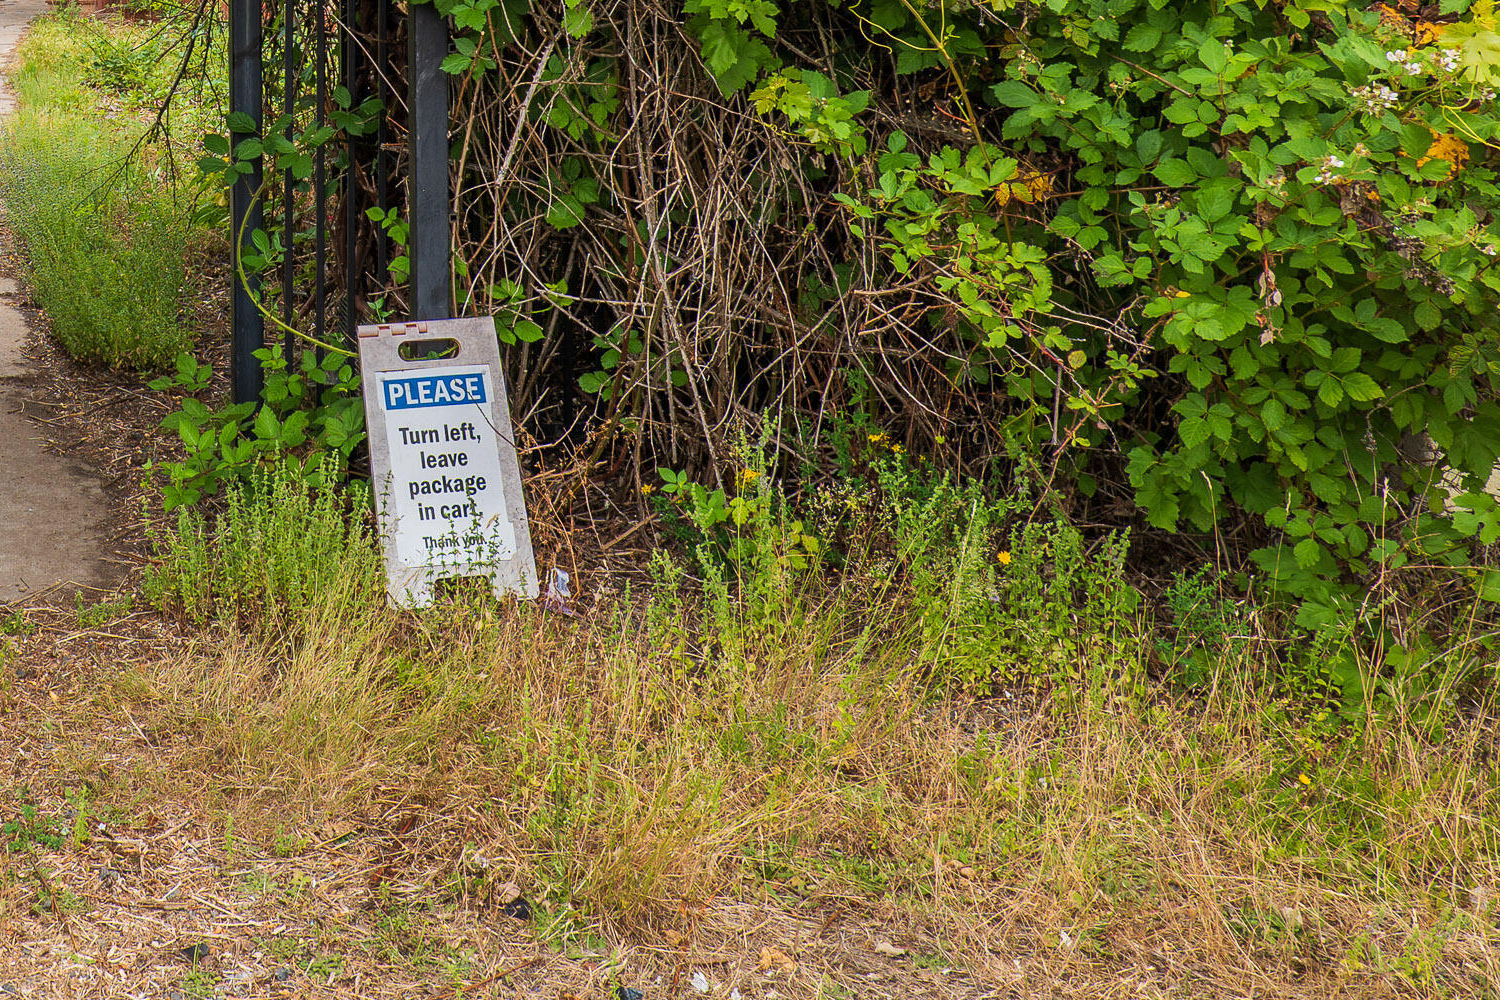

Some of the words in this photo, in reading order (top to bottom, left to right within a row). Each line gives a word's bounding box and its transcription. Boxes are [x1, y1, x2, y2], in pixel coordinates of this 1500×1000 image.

[388, 377, 481, 406] PLEASE
[399, 427, 440, 445] Turn
[443, 422, 481, 443] left,
[420, 451, 468, 469] leave
[409, 475, 486, 500] package
[418, 502, 436, 520] in
[422, 536, 460, 549] Thank
